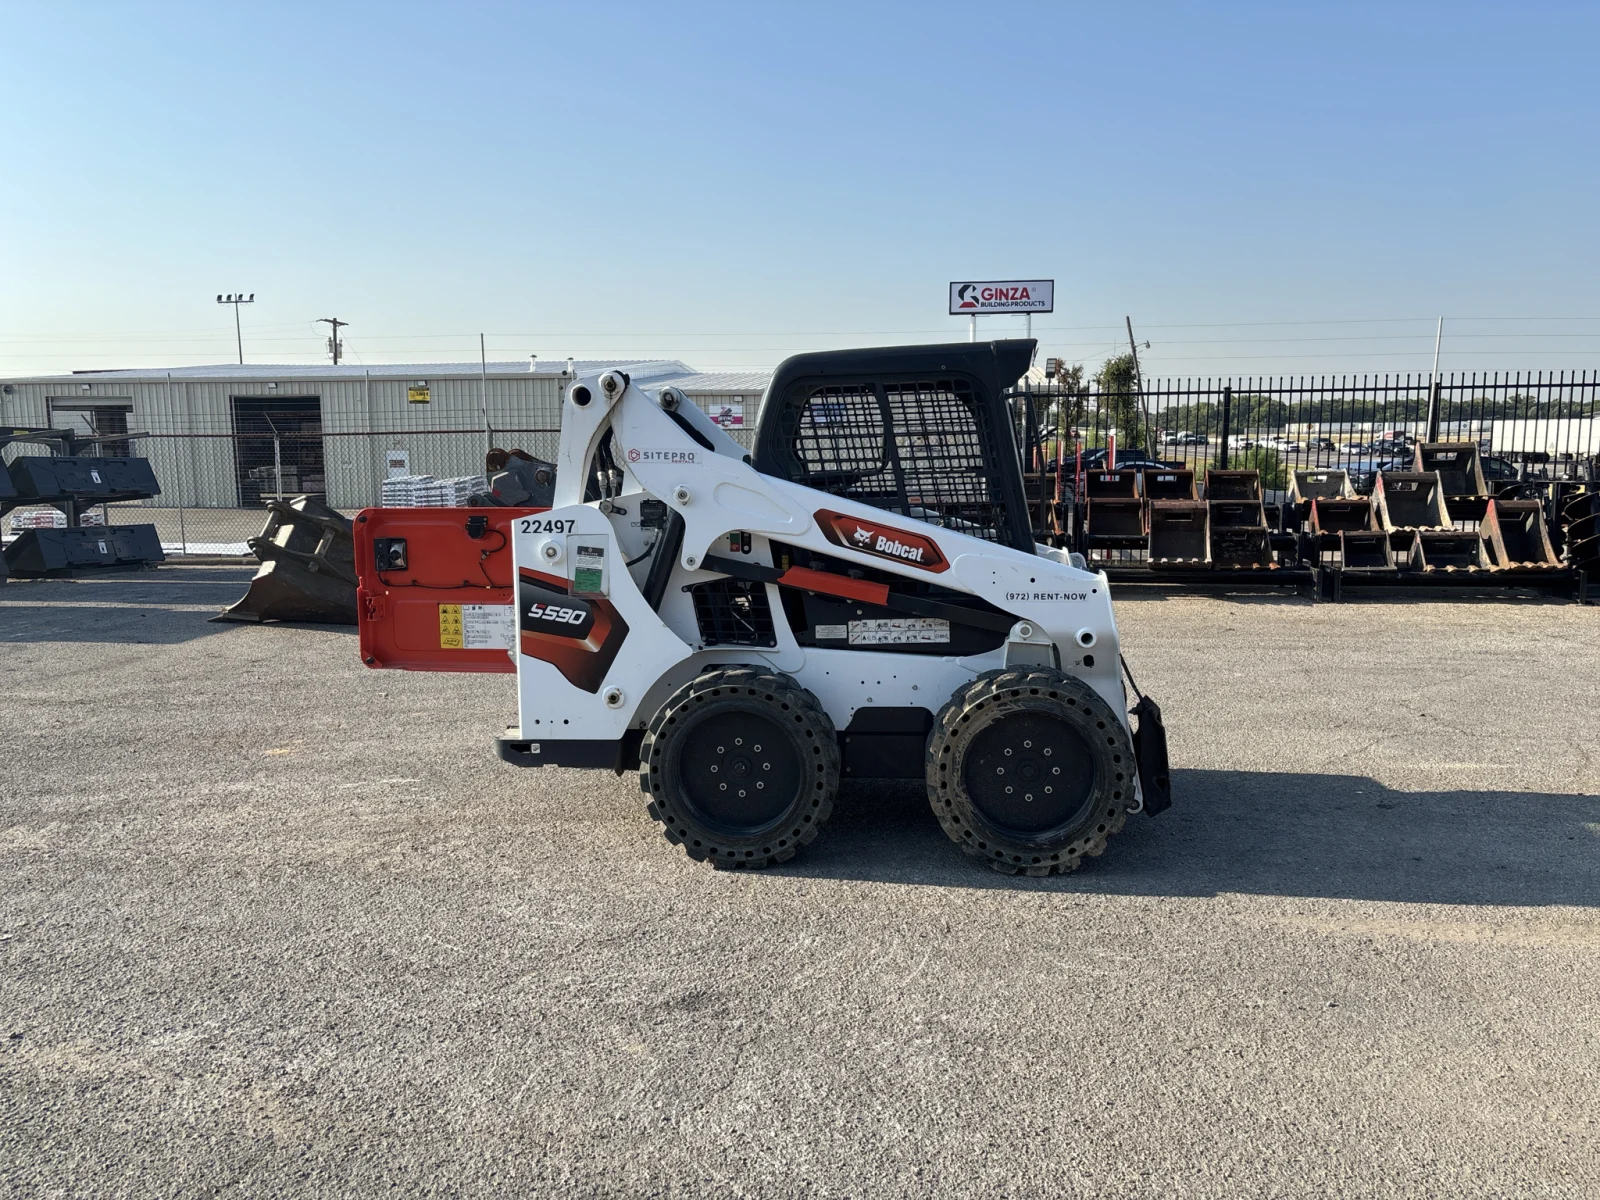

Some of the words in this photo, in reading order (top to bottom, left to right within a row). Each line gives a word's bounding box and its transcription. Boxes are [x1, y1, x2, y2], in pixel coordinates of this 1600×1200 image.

[981, 287, 1030, 301] GINZA
[643, 452, 695, 460] SITEPRO
[521, 520, 575, 533] 22497
[875, 535, 924, 561] Bobcat
[1005, 592, 1030, 601] (972)
[528, 603, 587, 625] S590
